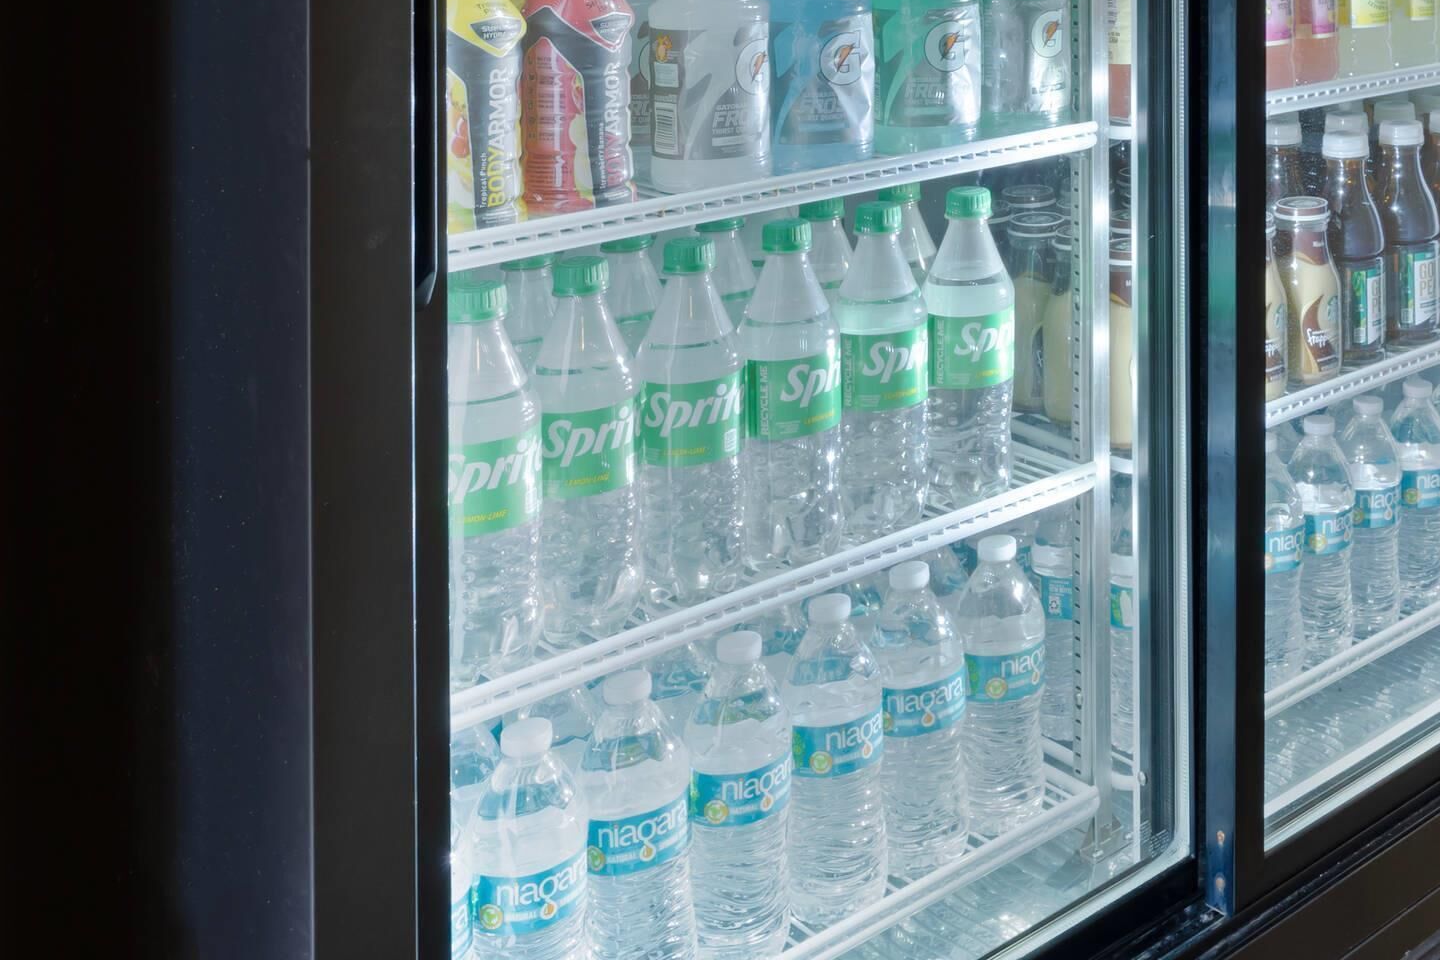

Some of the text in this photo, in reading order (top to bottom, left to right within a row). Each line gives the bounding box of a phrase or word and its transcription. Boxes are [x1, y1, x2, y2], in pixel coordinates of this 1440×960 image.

[487, 67, 508, 207] BODYARMOR
[479, 152, 488, 209] Tropical Punch
[936, 319, 945, 384] RECYCLE ME
[760, 365, 769, 435] RECYCLE ME
[888, 677, 963, 715] niagara
[597, 805, 688, 849] niagara
